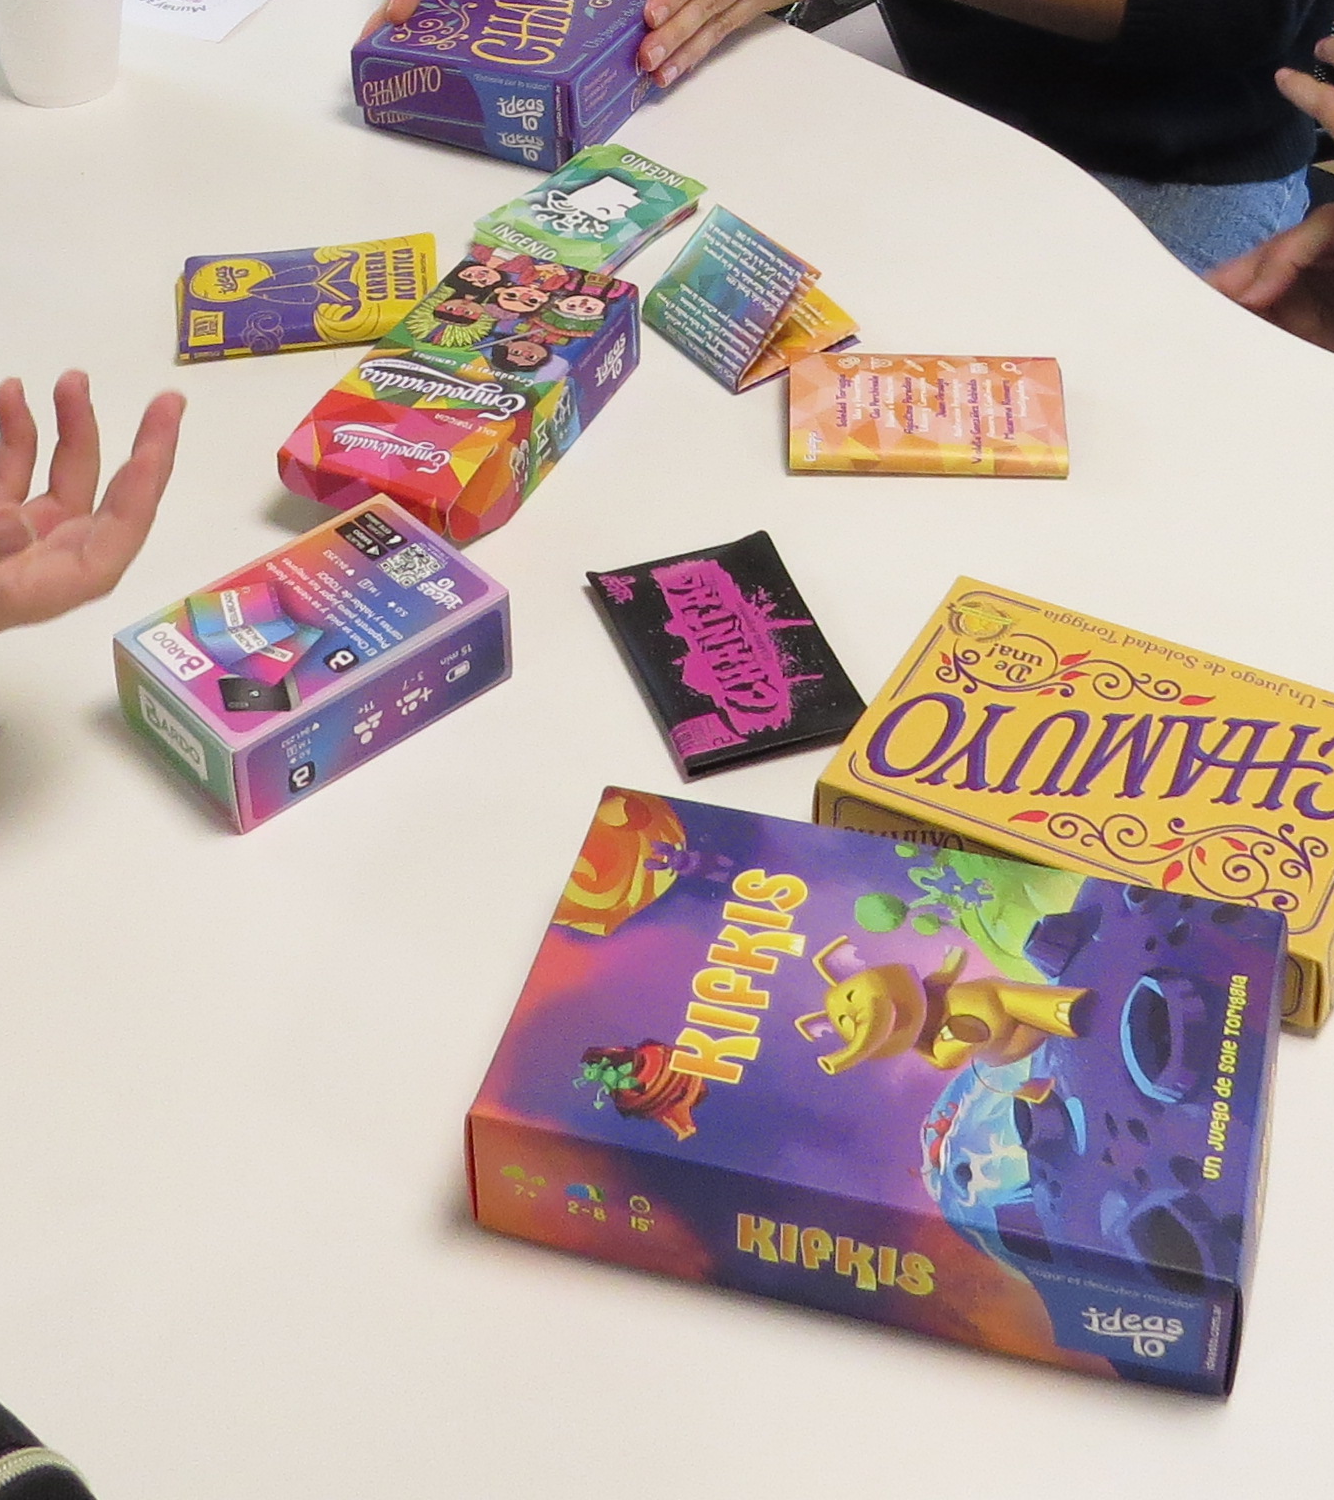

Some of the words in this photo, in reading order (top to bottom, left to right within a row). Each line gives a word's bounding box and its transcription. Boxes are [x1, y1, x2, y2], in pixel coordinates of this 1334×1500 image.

[363, 65, 442, 107] CHAMUYO
[496, 94, 545, 118] ideas
[620, 152, 685, 188] INGENIO
[491, 222, 560, 262] INGENIO
[361, 249, 391, 302] CARRERA
[385, 246, 420, 300] ACUÁTICA
[359, 356, 528, 422] Empoderadas
[332, 422, 453, 476] Empoderadas
[1040, 607, 1120, 645] Toriggia
[149, 629, 207, 677] BARDO
[984, 640, 1044, 671] una!
[1121, 633, 1200, 670] Soledad
[1201, 659, 1226, 679] de
[991, 657, 1038, 688] De
[1228, 666, 1289, 698] juego
[1287, 688, 1317, 709] Un
[669, 867, 810, 1086] KIPKIS
[1210, 1075, 1234, 1098] de
[1200, 1155, 1222, 1180] un
[735, 1211, 937, 1297] KIPKIS
[1081, 1306, 1186, 1351] ideas
